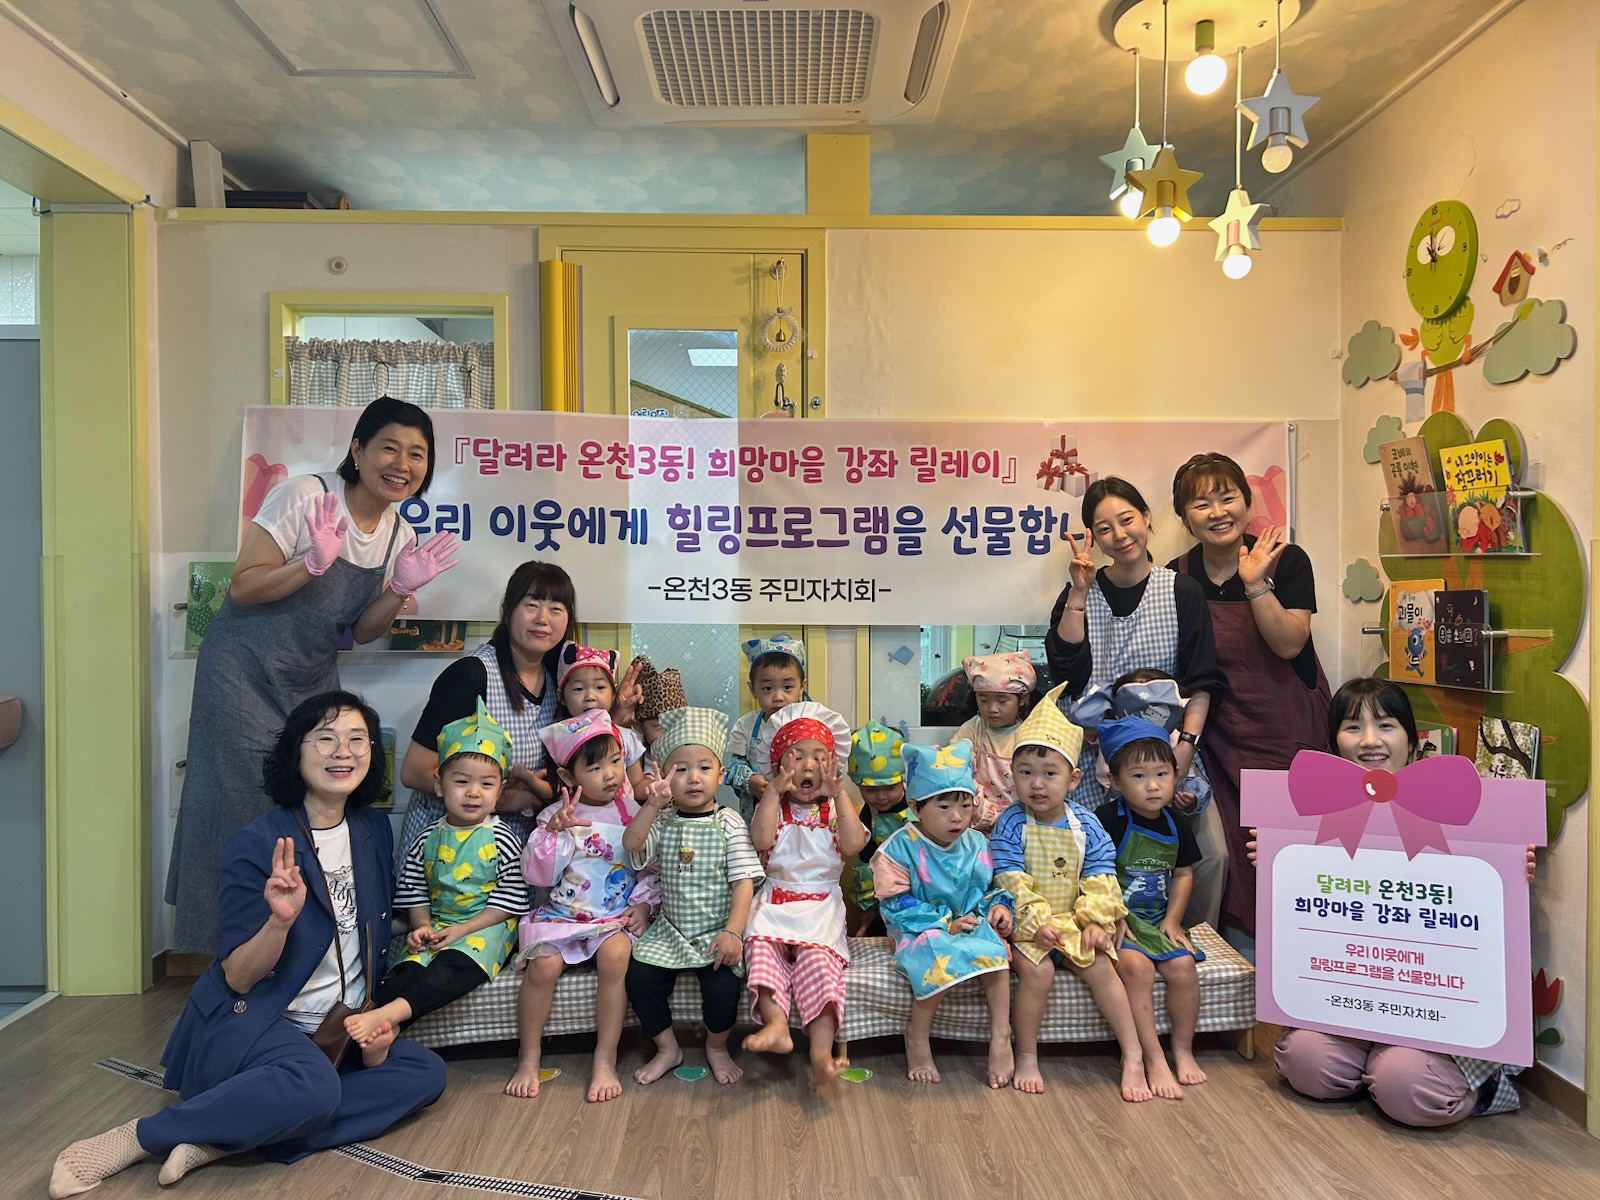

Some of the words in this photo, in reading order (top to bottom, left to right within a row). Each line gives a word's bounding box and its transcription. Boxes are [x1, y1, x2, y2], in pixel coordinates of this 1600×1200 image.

[454, 437, 568, 475] 『달려라
[578, 441, 696, 482] 온천3동!
[708, 447, 826, 484] 희망마을
[836, 447, 899, 485] 강좌
[910, 447, 1018, 485] 릴레이』
[1454, 467, 1498, 491] 잠꾸러기
[399, 497, 471, 547] 우리
[489, 499, 649, 552] 이웃에게
[666, 504, 926, 556] 힐링프로그램을
[941, 504, 1094, 556] 선물합니
[759, 577, 892, 603] 주민자치회-
[1398, 603, 1423, 624] 괴물이
[1317, 874, 1371, 895] 달려라
[1378, 879, 1453, 905] 온천3동!
[1294, 897, 1365, 922] 희망마을
[1372, 902, 1411, 924] 강좌
[1418, 908, 1480, 931] 릴레이
[1345, 943, 1370, 958] 우리
[1371, 947, 1425, 966] 이웃에게
[1310, 957, 1395, 981] 힐링프로그램을
[1398, 970, 1465, 991] 선물합니다
[1378, 1001, 1447, 1022] 주민자치회-
